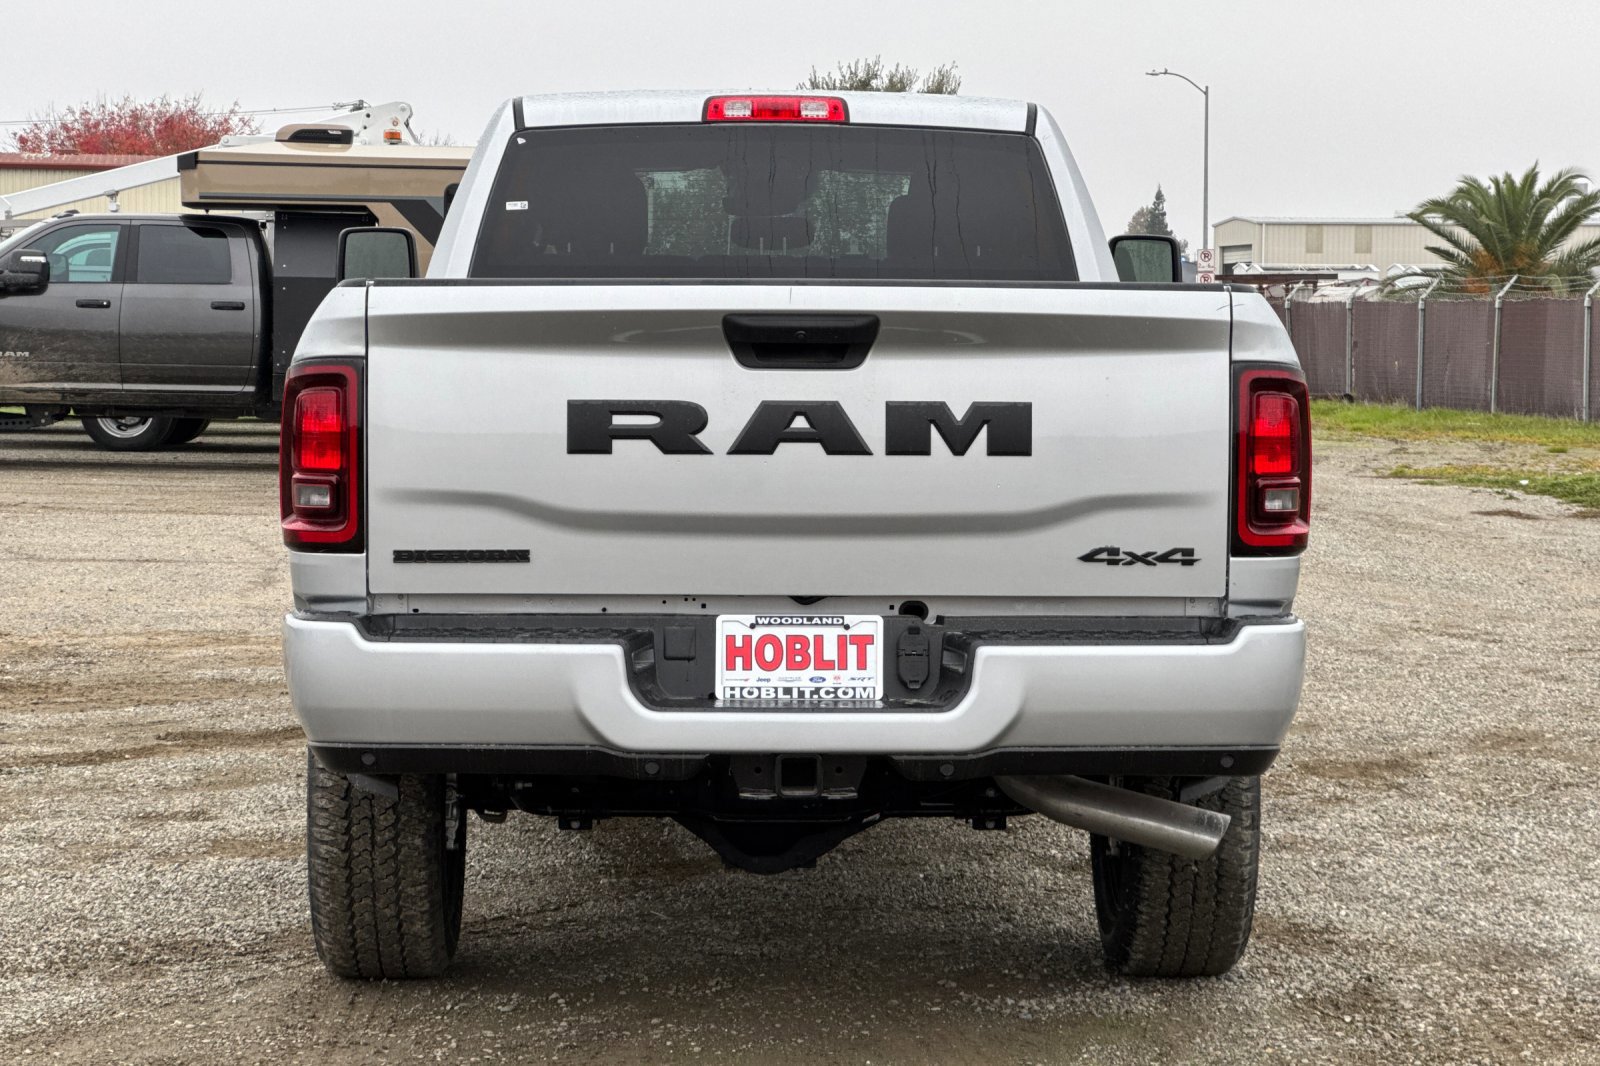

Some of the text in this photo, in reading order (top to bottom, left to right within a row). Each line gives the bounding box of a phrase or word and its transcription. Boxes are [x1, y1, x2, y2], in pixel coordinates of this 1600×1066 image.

[567, 399, 1033, 457] RAM
[725, 634, 874, 671] HOBLIT
[756, 676, 771, 684] Jeep
[725, 687, 874, 699] HOBLIT.COM
